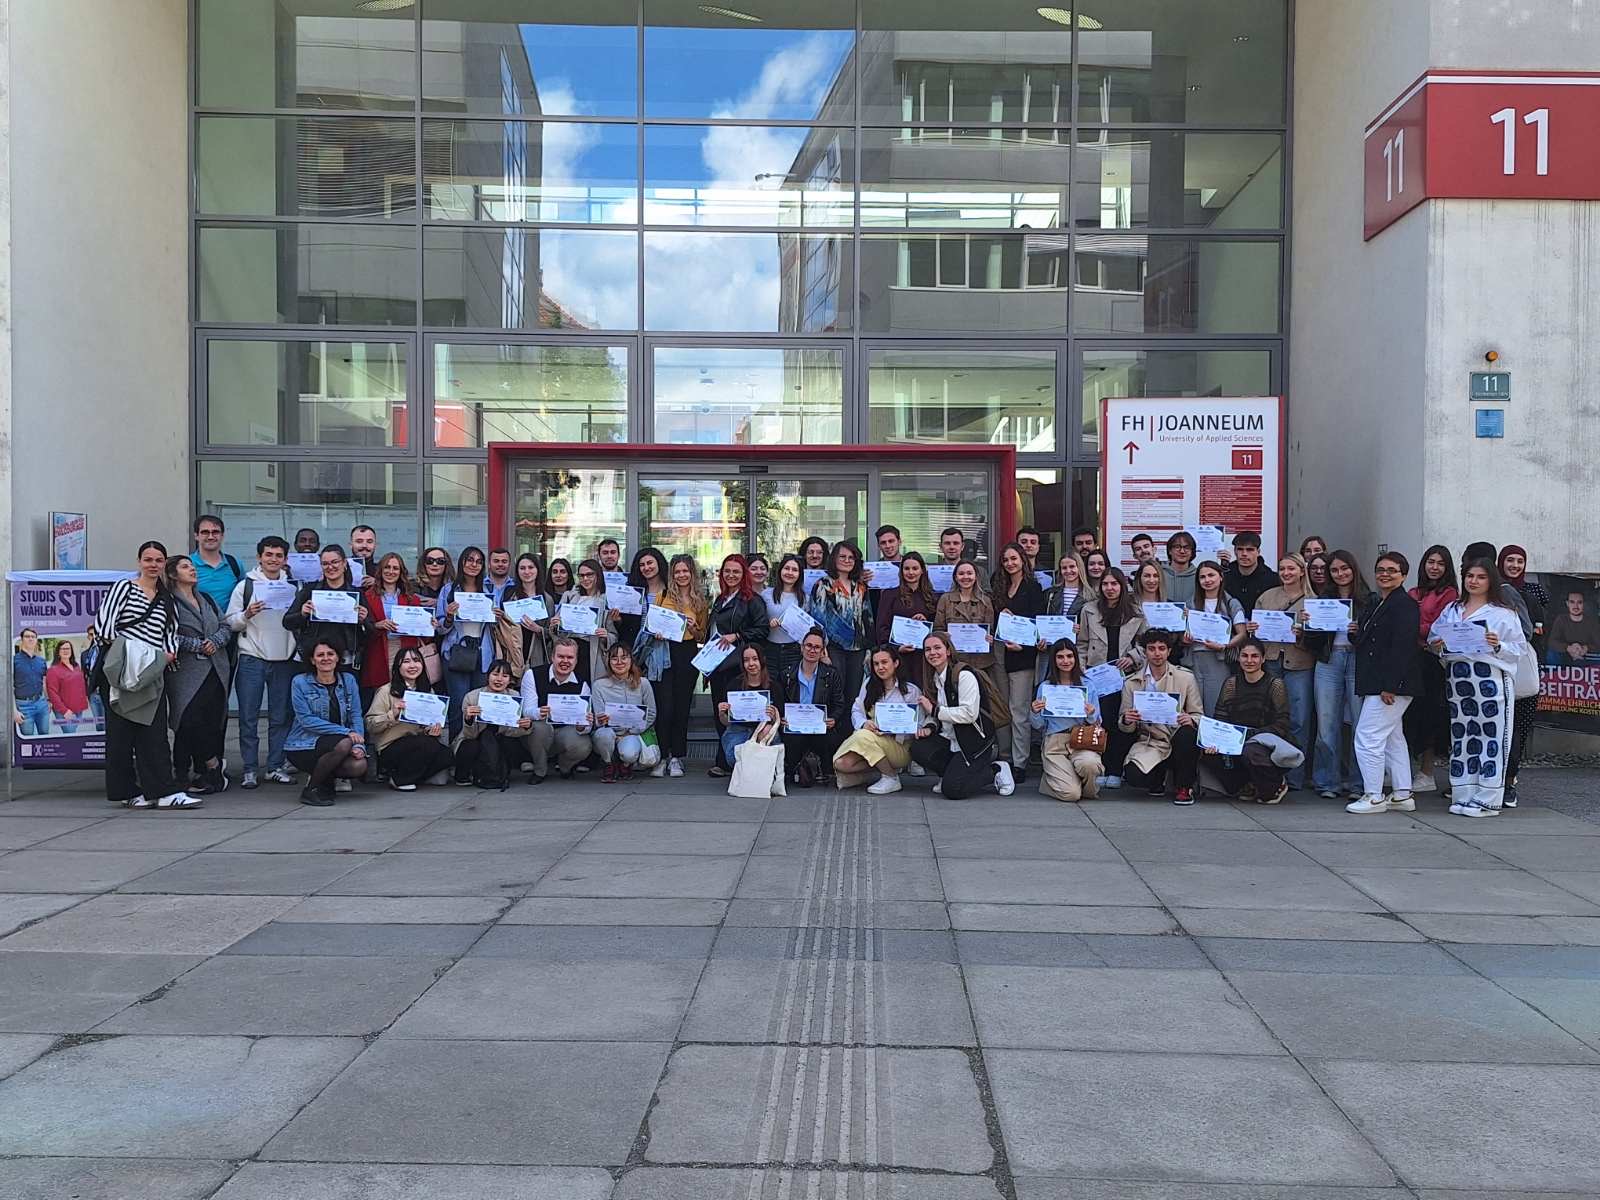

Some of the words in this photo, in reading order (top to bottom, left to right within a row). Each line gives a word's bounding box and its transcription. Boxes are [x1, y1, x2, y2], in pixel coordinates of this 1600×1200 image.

[1490, 107, 1549, 176] 11
[1383, 128, 1405, 202] 11
[1482, 375, 1498, 392] 11
[1122, 415, 1145, 431] FH
[1158, 414, 1264, 432] JOANNEUM
[1159, 434, 1195, 443] University
[1197, 434, 1204, 442] of
[1206, 434, 1232, 443] Applied
[1233, 434, 1264, 442] Sciences
[1242, 454, 1252, 465] 11
[20, 590, 56, 602] STUDIS
[59, 589, 106, 617] STU
[20, 604, 57, 617] WÄHLEN
[1539, 681, 1600, 700] BEITRÄ
[1536, 696, 1566, 706] AMMA
